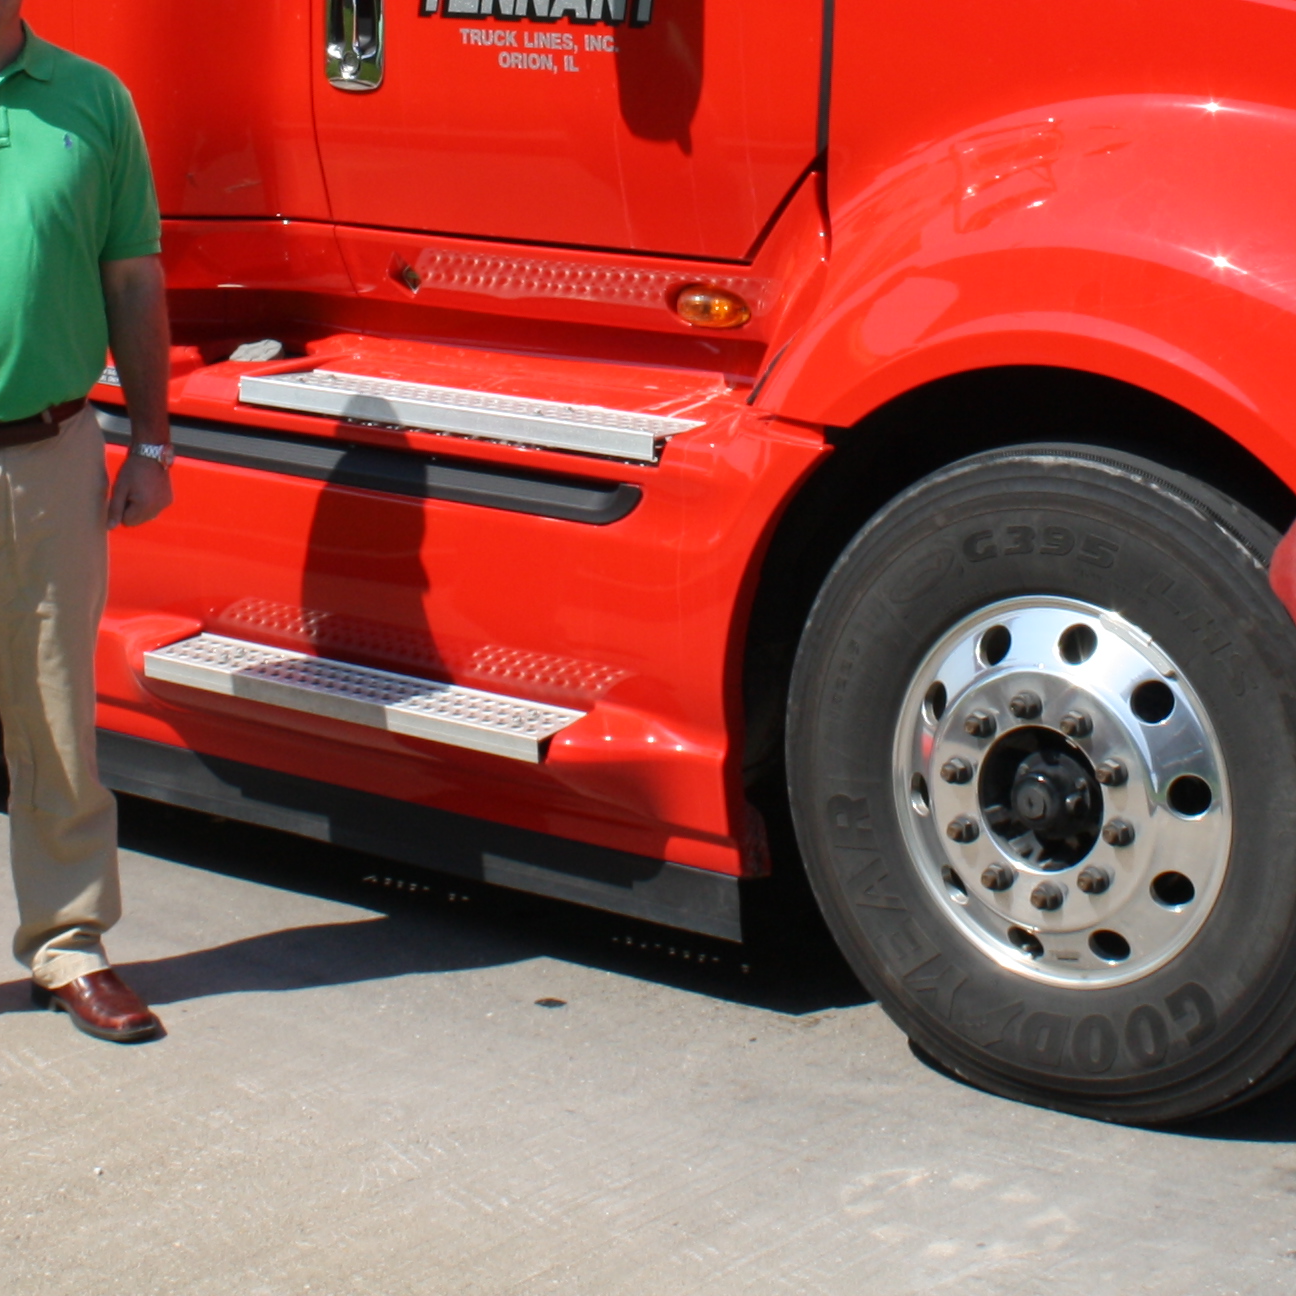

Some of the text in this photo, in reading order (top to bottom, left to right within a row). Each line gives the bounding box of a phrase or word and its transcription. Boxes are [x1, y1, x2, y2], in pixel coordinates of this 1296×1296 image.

[459, 28, 620, 53] TRUCK LINES, INC.
[498, 51, 579, 74] ORION, IL
[962, 523, 1120, 570] G395
[826, 792, 1219, 1075] GOODYEAR
